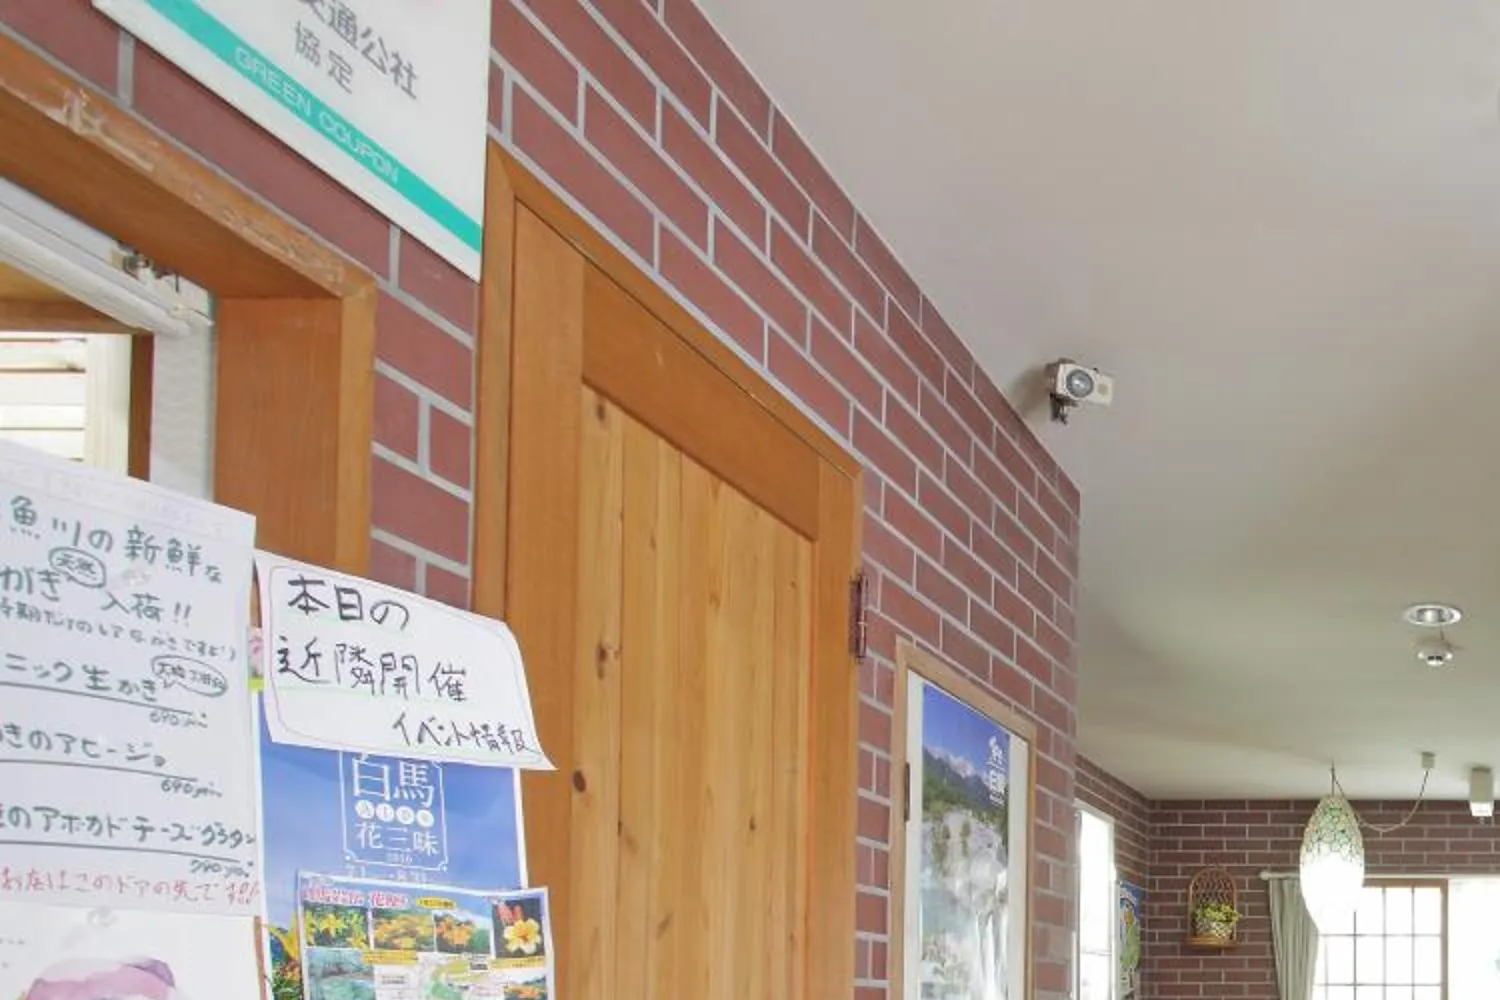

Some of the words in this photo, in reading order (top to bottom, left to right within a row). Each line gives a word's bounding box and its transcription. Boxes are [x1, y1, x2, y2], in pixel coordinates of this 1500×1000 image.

[295, 20, 354, 94] 協定
[233, 46, 312, 117] GREEN
[318, 111, 400, 184] COUPON
[288, 574, 410, 631] 本日の
[277, 635, 468, 702] 近隣開催
[0, 722, 167, 767] きのアヒージョ
[352, 752, 436, 808] 白馬
[357, 822, 441, 857] 花三昧
